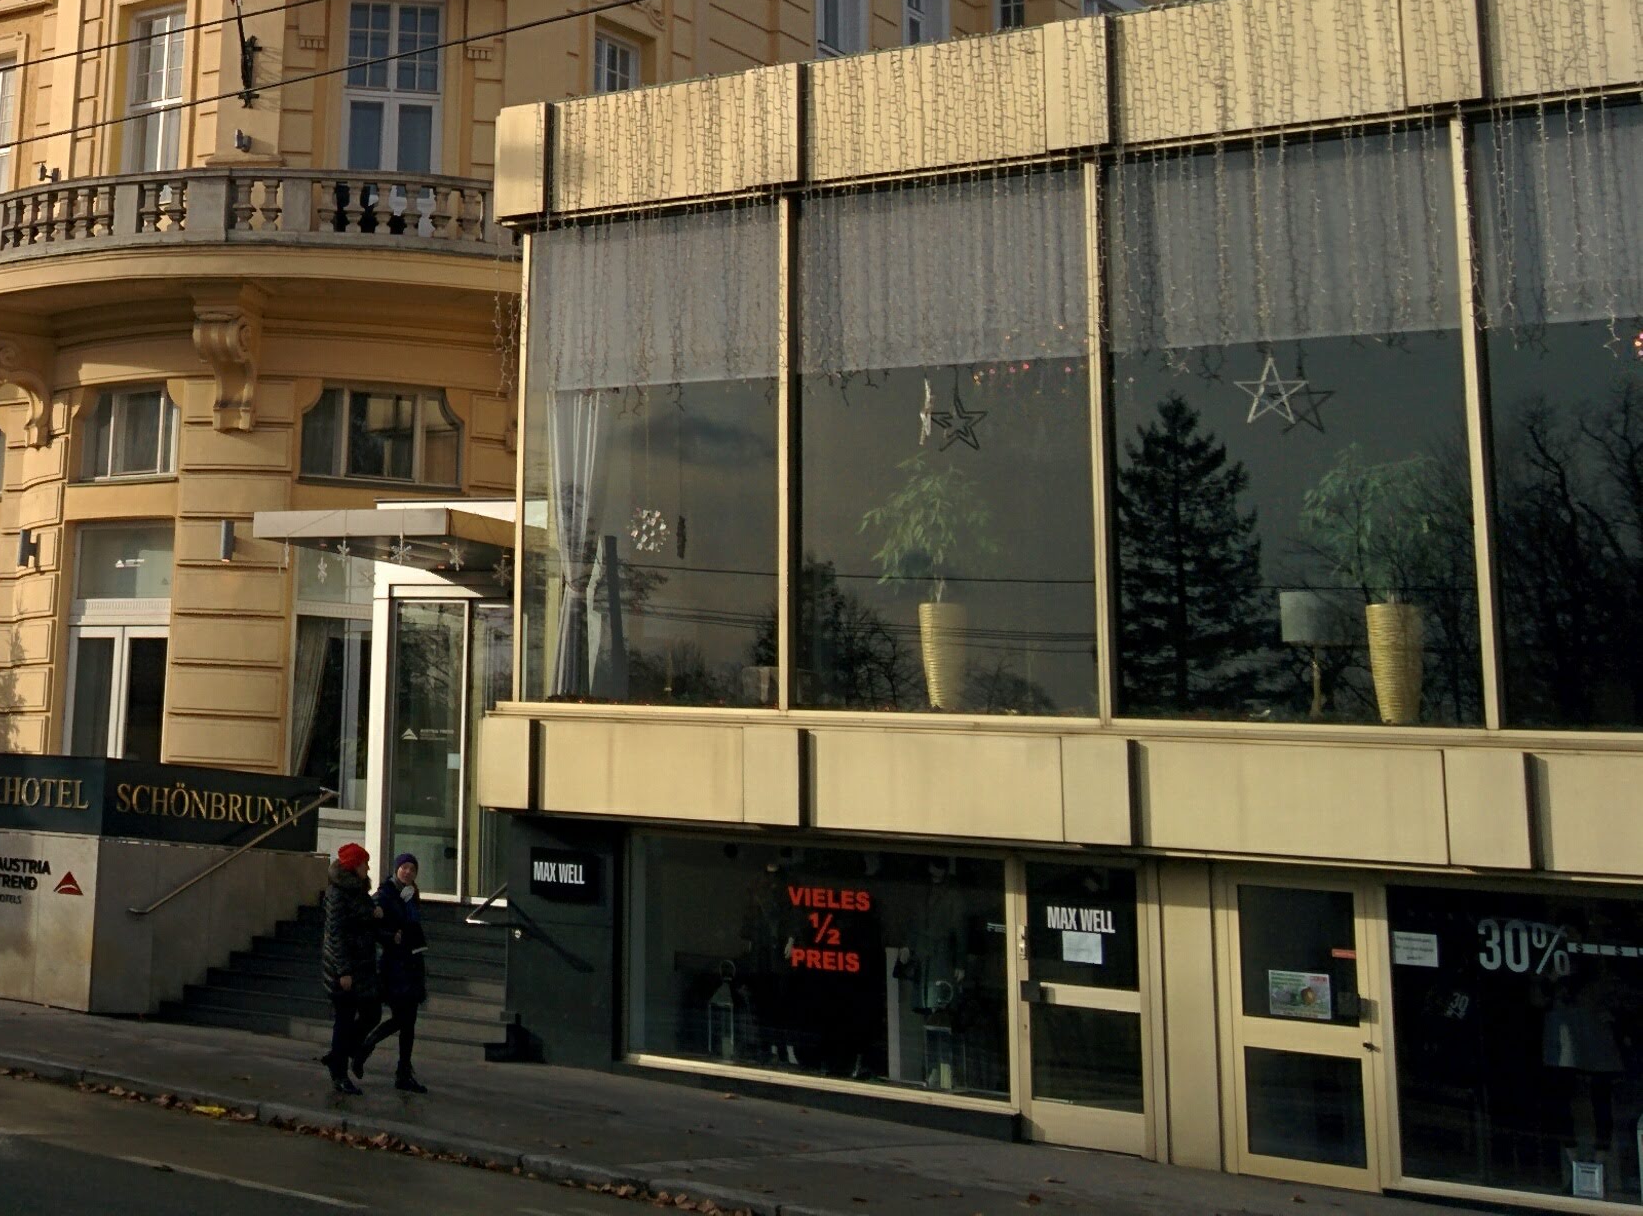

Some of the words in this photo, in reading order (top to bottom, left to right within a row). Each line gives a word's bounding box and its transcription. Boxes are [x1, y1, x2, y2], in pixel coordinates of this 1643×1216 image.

[116, 782, 301, 827] SCHÖNBRUNN
[533, 861, 557, 882] MAX
[558, 863, 586, 885] WELL
[787, 886, 871, 912] VIELES
[1046, 905, 1078, 931] MAX
[1079, 908, 1117, 934] WELL
[791, 947, 861, 973] PREIS
[1477, 918, 1572, 977] 30%
